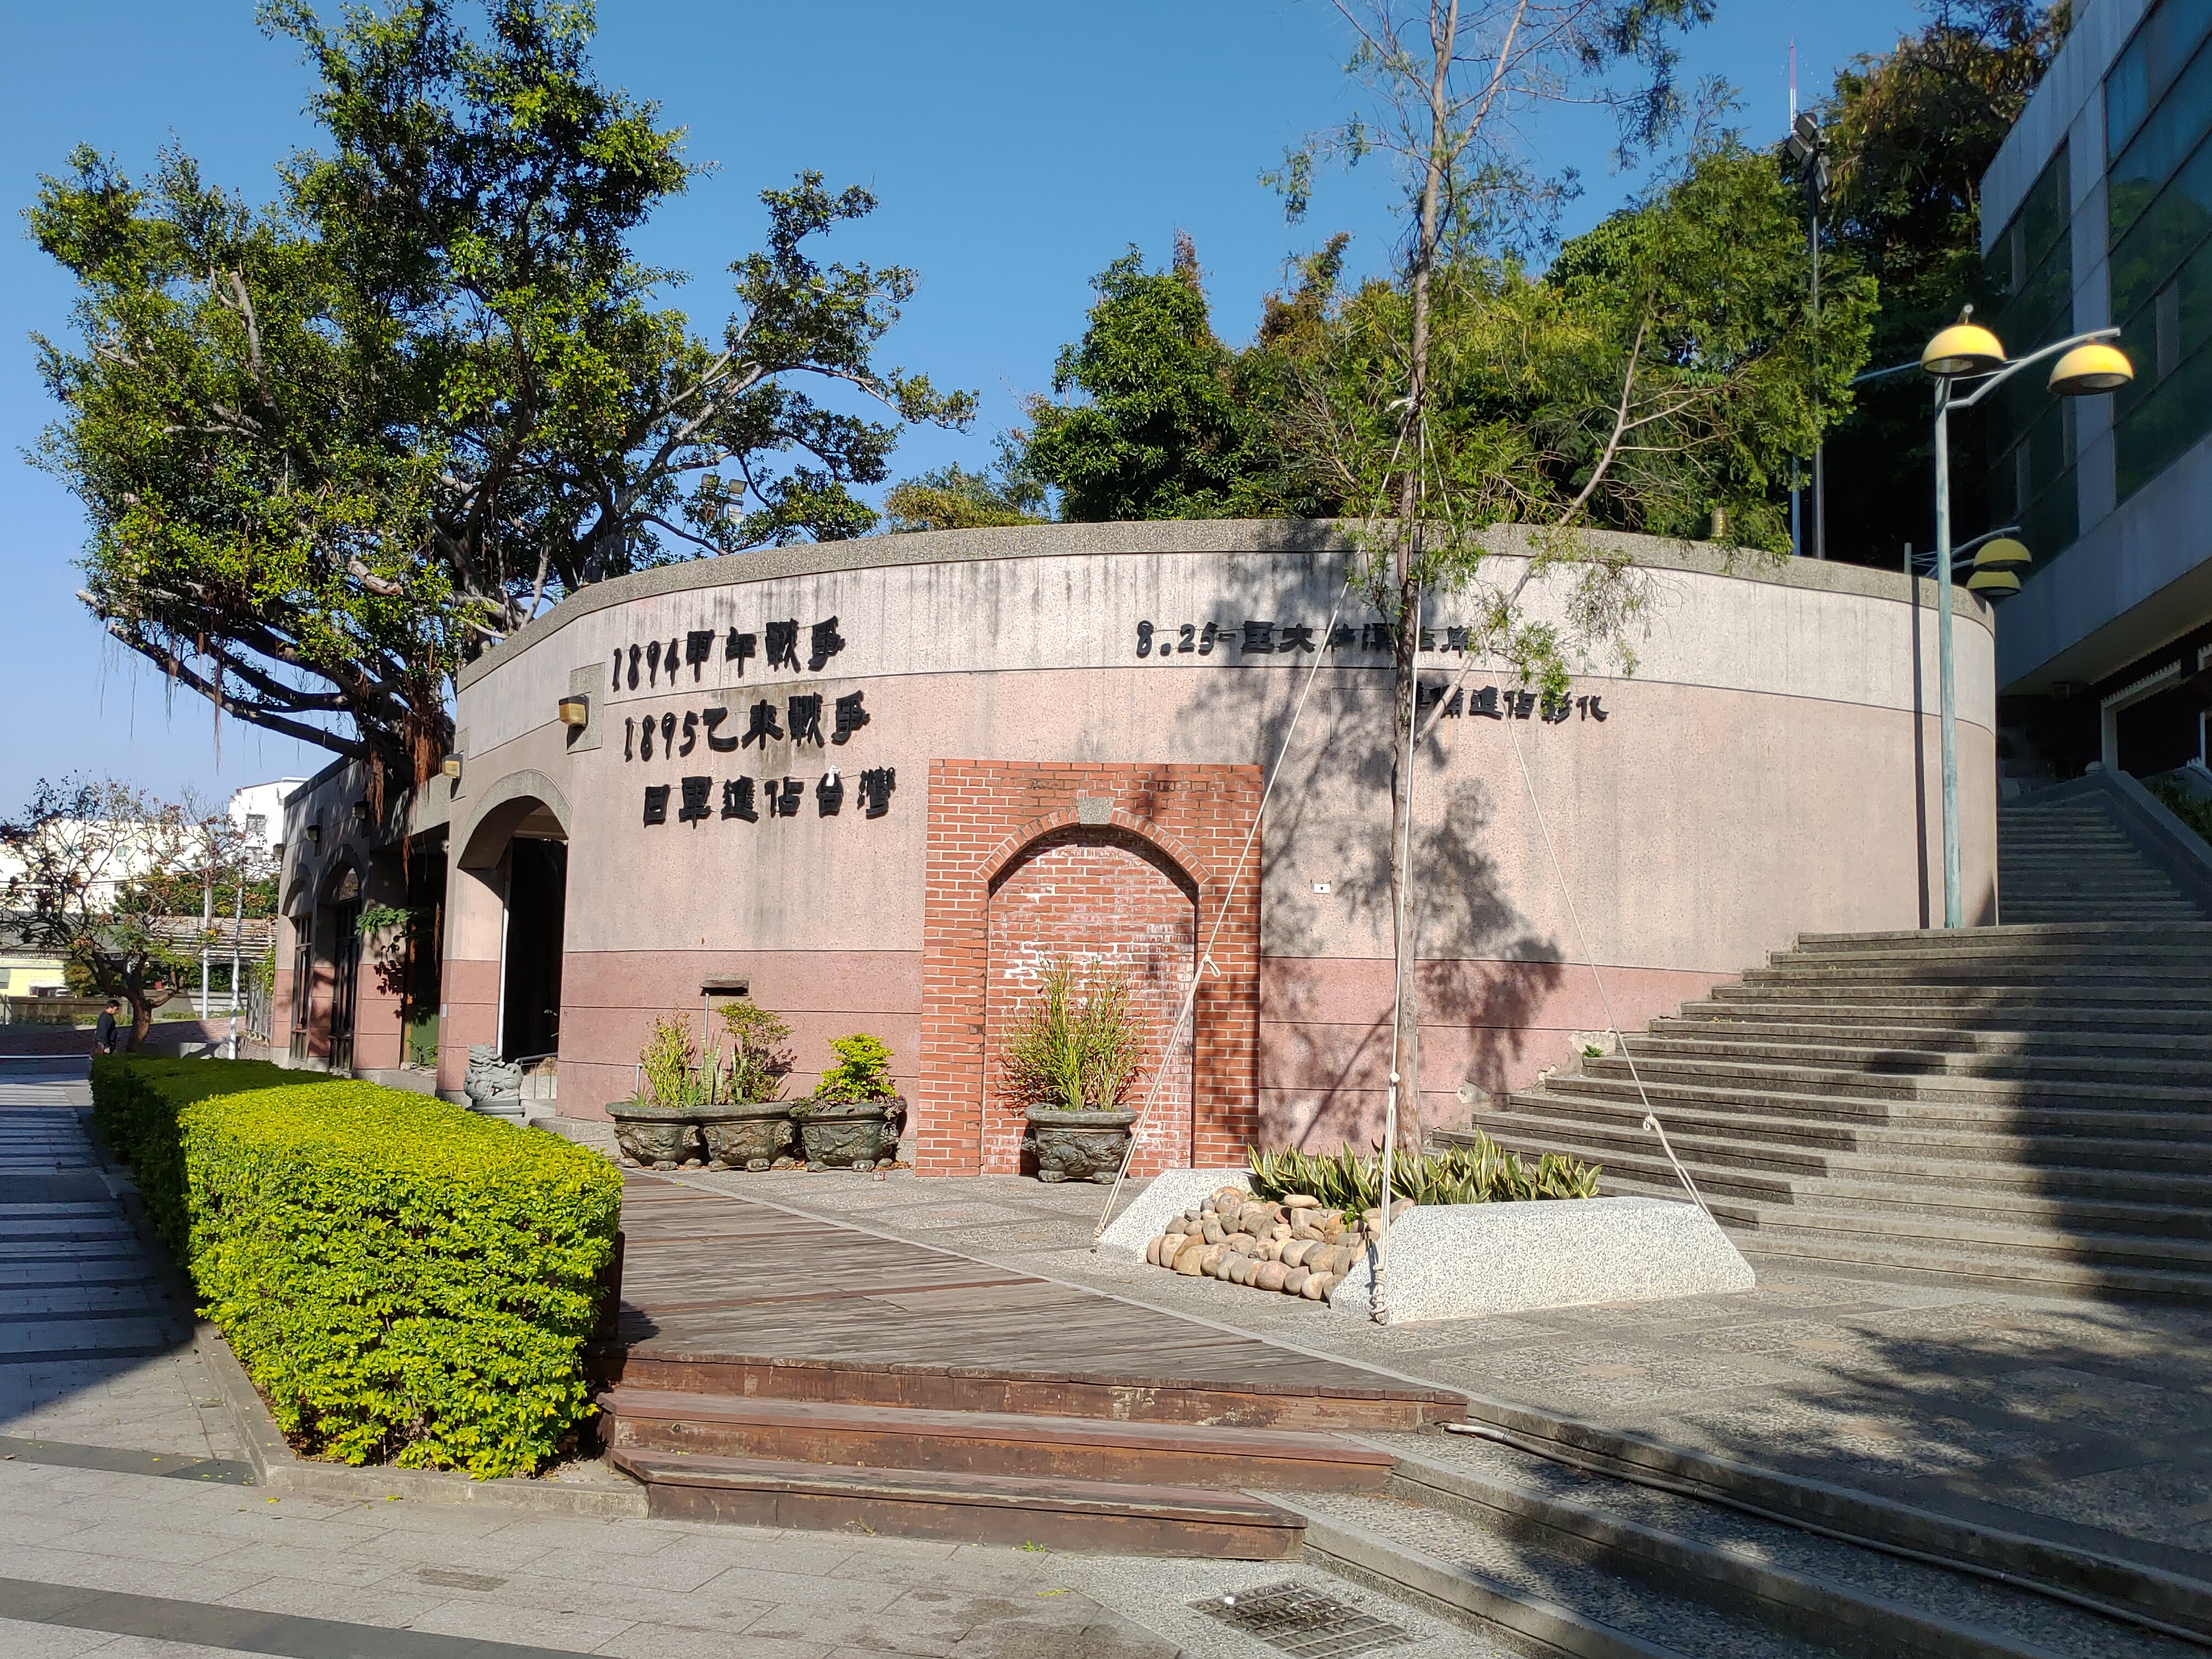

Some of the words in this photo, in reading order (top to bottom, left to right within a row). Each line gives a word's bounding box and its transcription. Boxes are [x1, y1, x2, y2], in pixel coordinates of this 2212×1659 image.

[613, 616, 846, 692] 1894甲午戰爭
[624, 690, 870, 762] 1895乙未戰爭
[644, 766, 896, 830] 日軍進佔台灣
